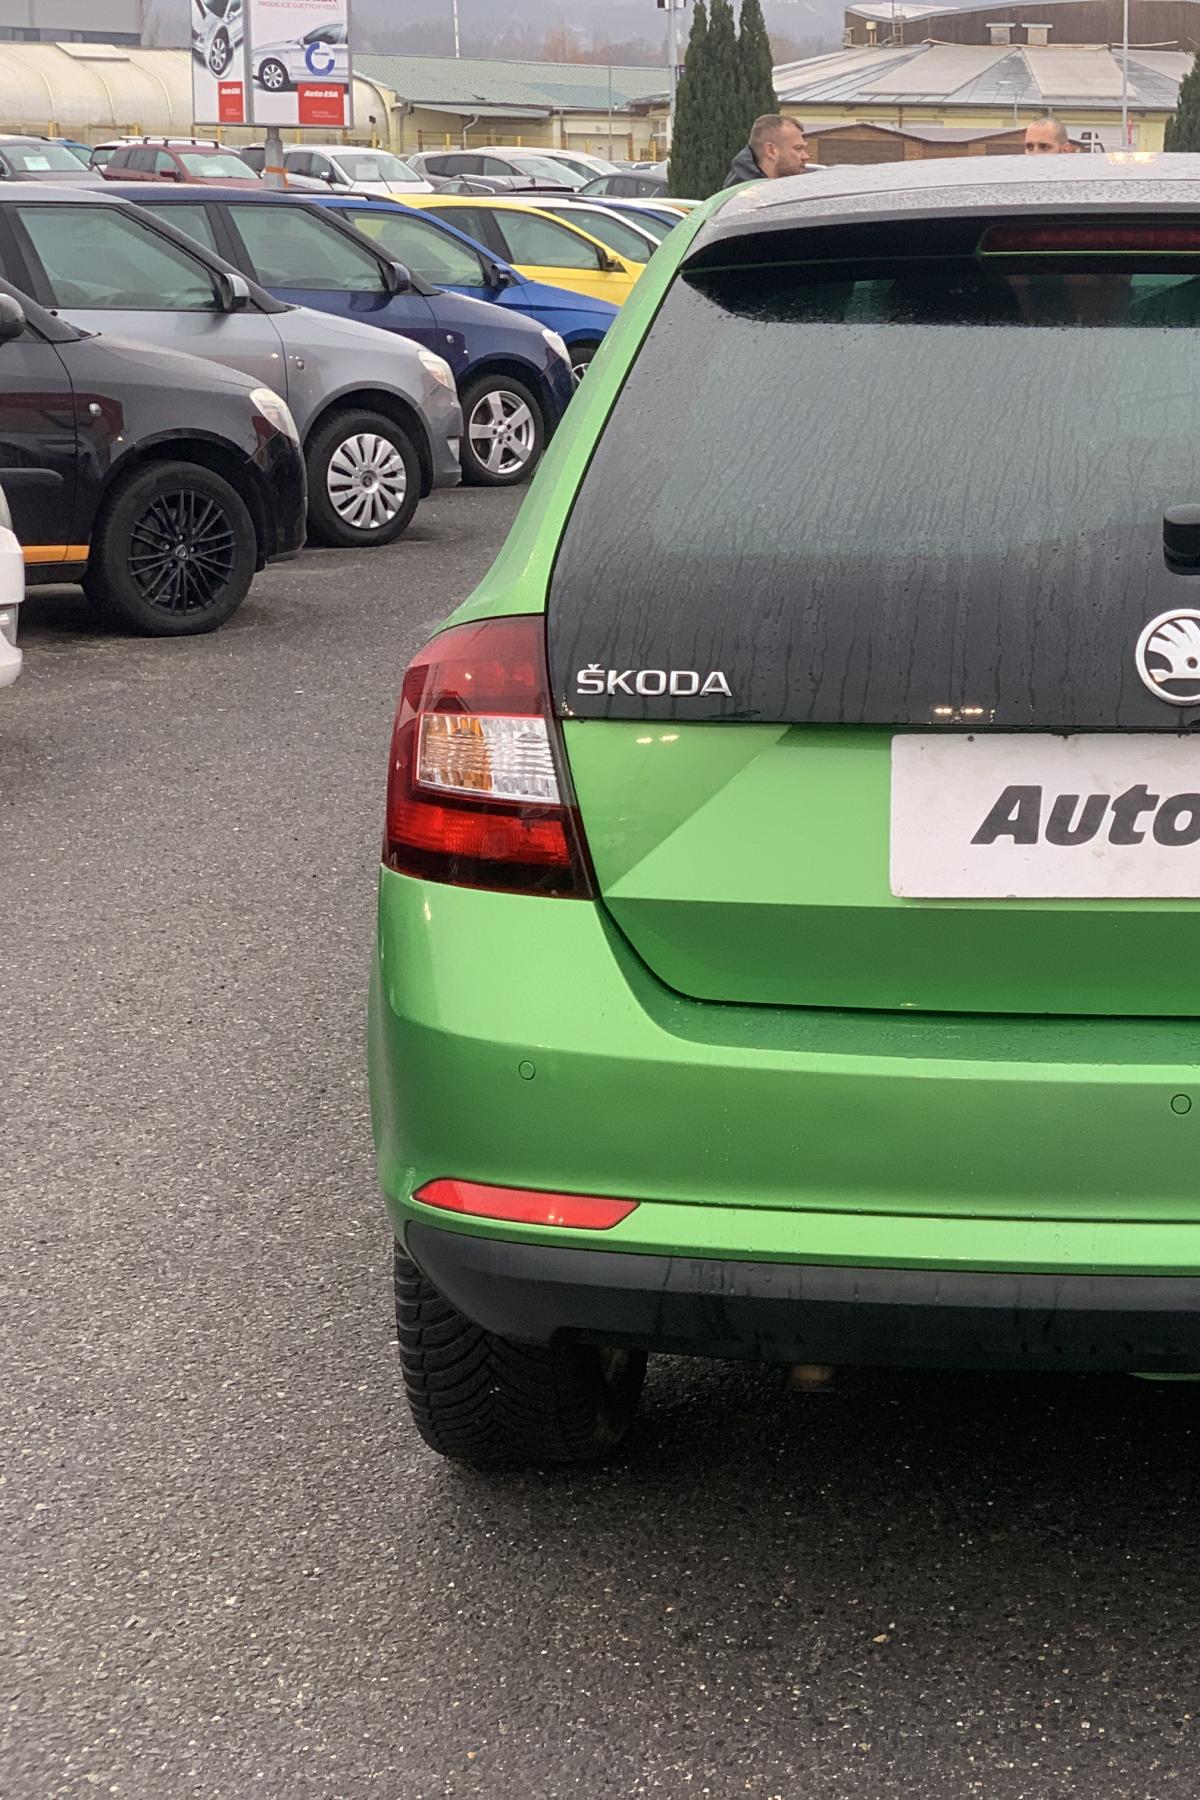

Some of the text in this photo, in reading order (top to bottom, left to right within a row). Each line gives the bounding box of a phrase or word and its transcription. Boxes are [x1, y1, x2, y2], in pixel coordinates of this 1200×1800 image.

[304, 90, 339, 98] Auto ESA
[577, 664, 732, 697] ŠKODA
